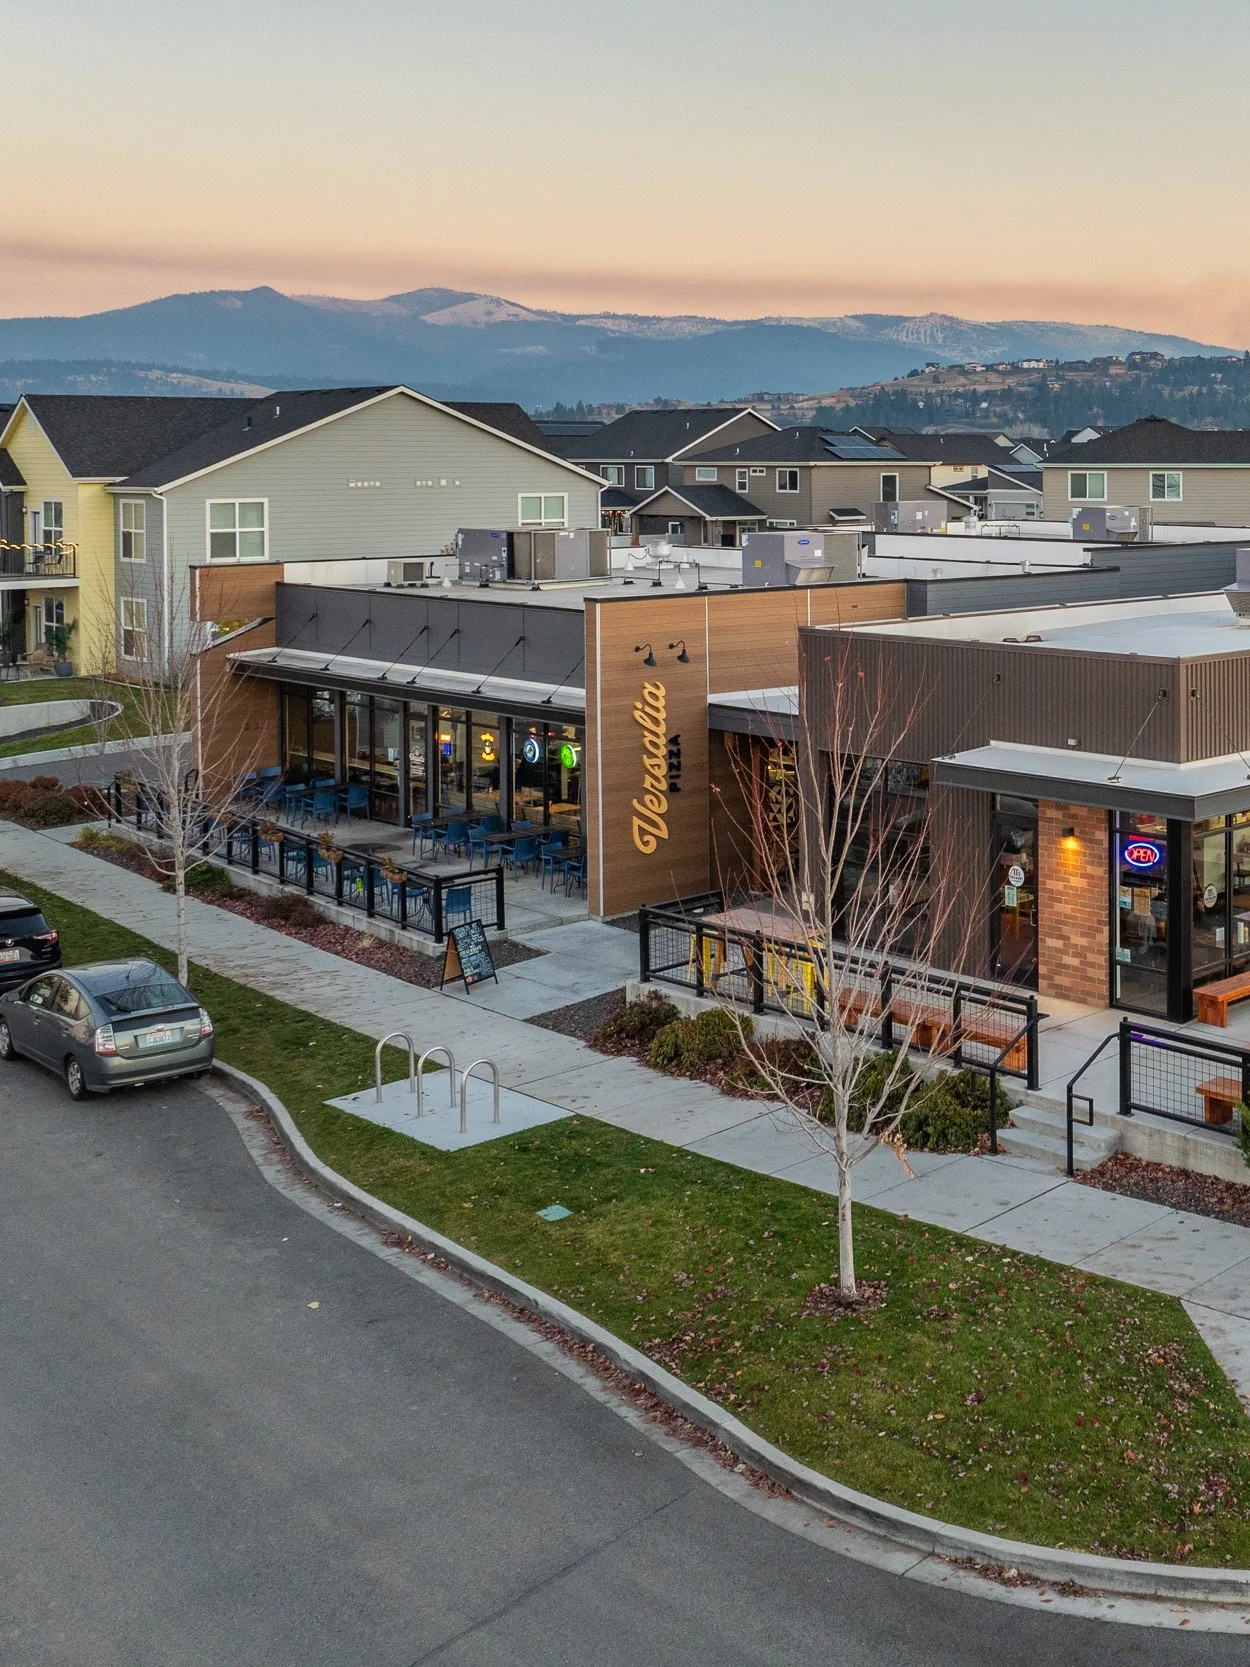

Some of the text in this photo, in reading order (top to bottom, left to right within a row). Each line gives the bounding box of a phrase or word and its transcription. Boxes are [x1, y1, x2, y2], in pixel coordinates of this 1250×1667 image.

[633, 681, 669, 855] Versalia
[668, 733, 682, 793] PIZZA
[1127, 847, 1156, 862] OPEN
